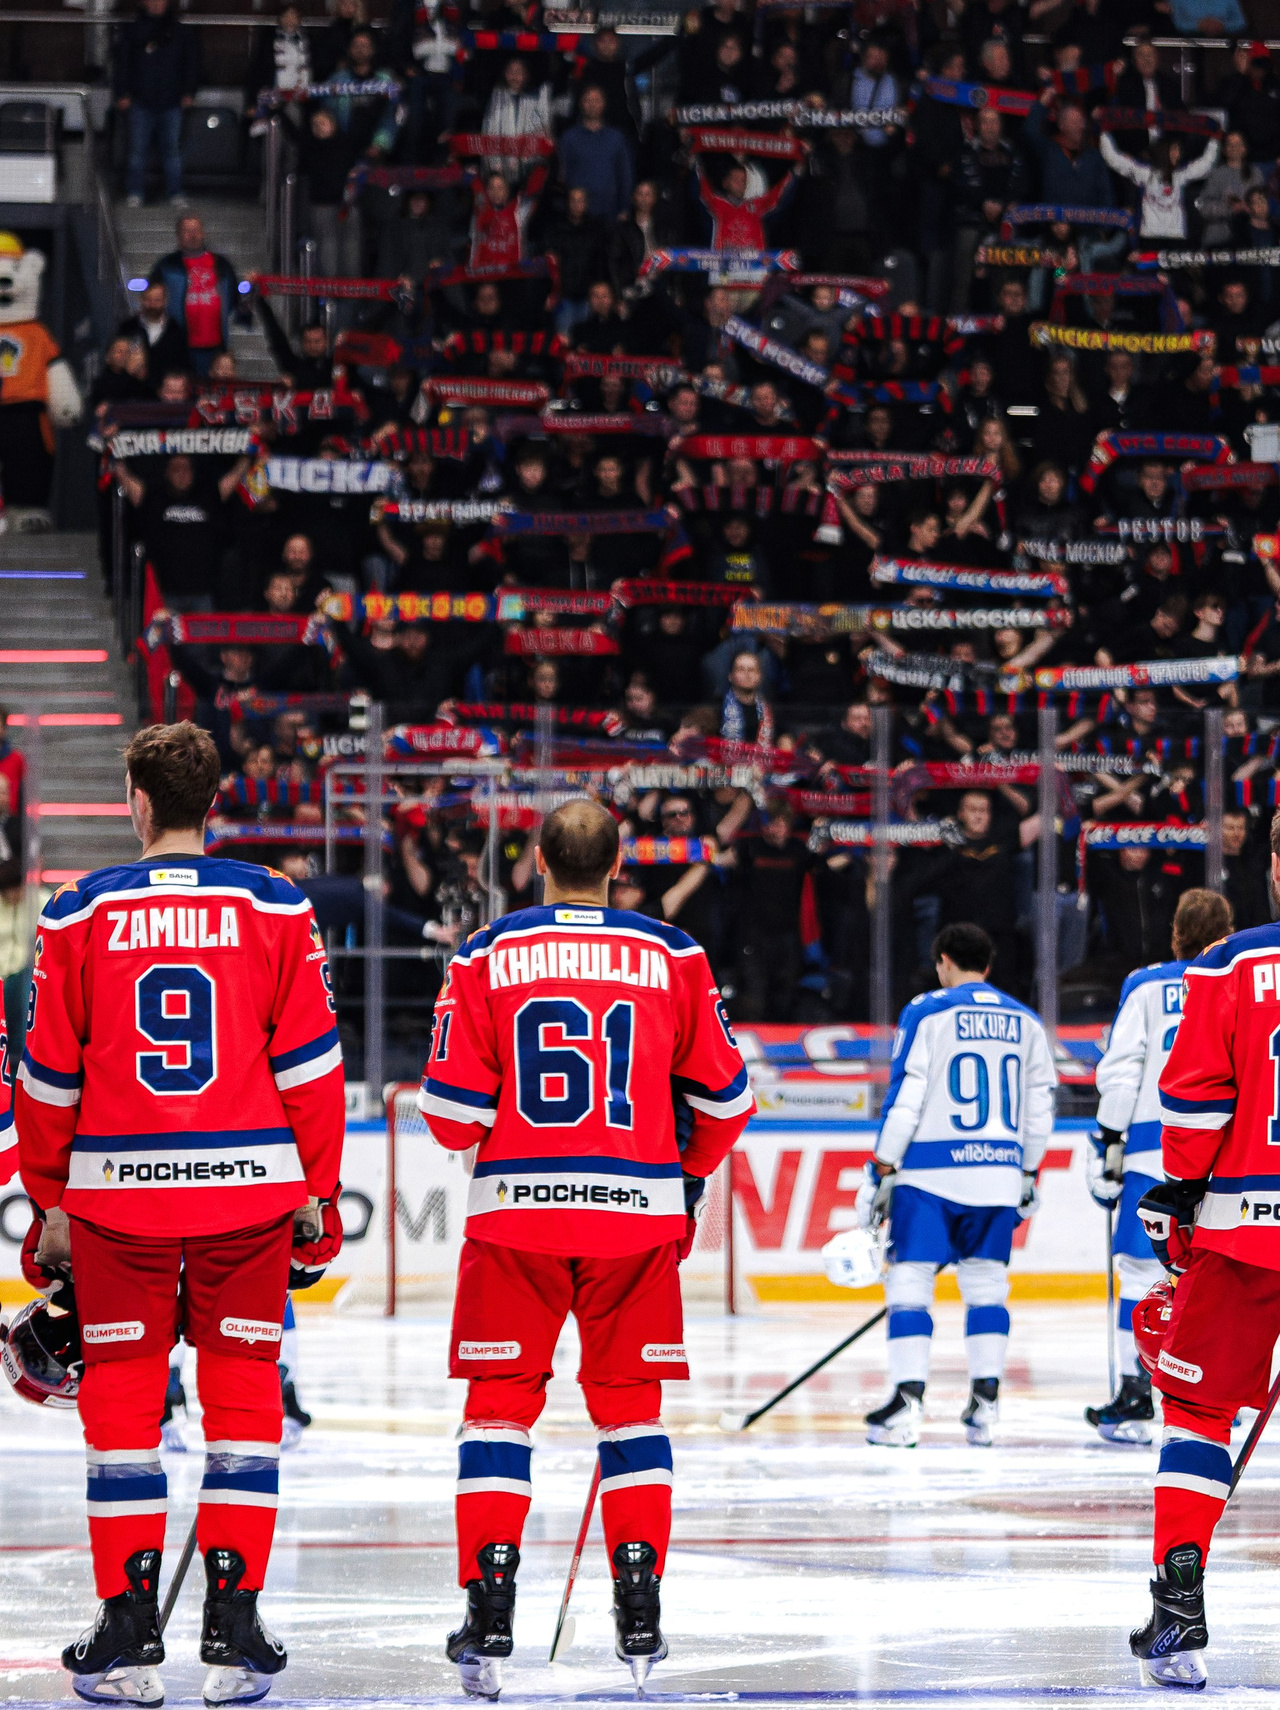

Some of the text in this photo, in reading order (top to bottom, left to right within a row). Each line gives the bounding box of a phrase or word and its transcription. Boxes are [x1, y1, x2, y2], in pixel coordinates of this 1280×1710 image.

[1107, 332, 1191, 354] МОСКВА
[109, 427, 250, 459] ЦСКА МОСКВА
[265, 455, 390, 493] ЦСКА
[891, 609, 951, 629] ЦСКА
[955, 610, 1047, 629] МОСКВА
[323, 734, 367, 756] ЦСК
[107, 906, 239, 951] ZAMULA
[489, 942, 669, 991] KHAIRULLIN
[135, 963, 217, 1096] 9
[957, 1012, 1019, 1041] SIKURA
[513, 996, 635, 1131] 61
[948, 1051, 1022, 1133] 90
[118, 1159, 267, 1183] РОСНЕФТЬ
[512, 1183, 649, 1209] РОСНЕФТЬ
[86, 1326, 139, 1338] OLIMPBET
[226, 1321, 280, 1338] OLIMPBET
[460, 1345, 516, 1358] OLIMPBET
[647, 1348, 686, 1357] OLIMPBE
[1160, 1356, 1198, 1378] OLIMPBET
[1175, 1553, 1196, 1562] CCM
[1156, 1623, 1182, 1652] CCM
